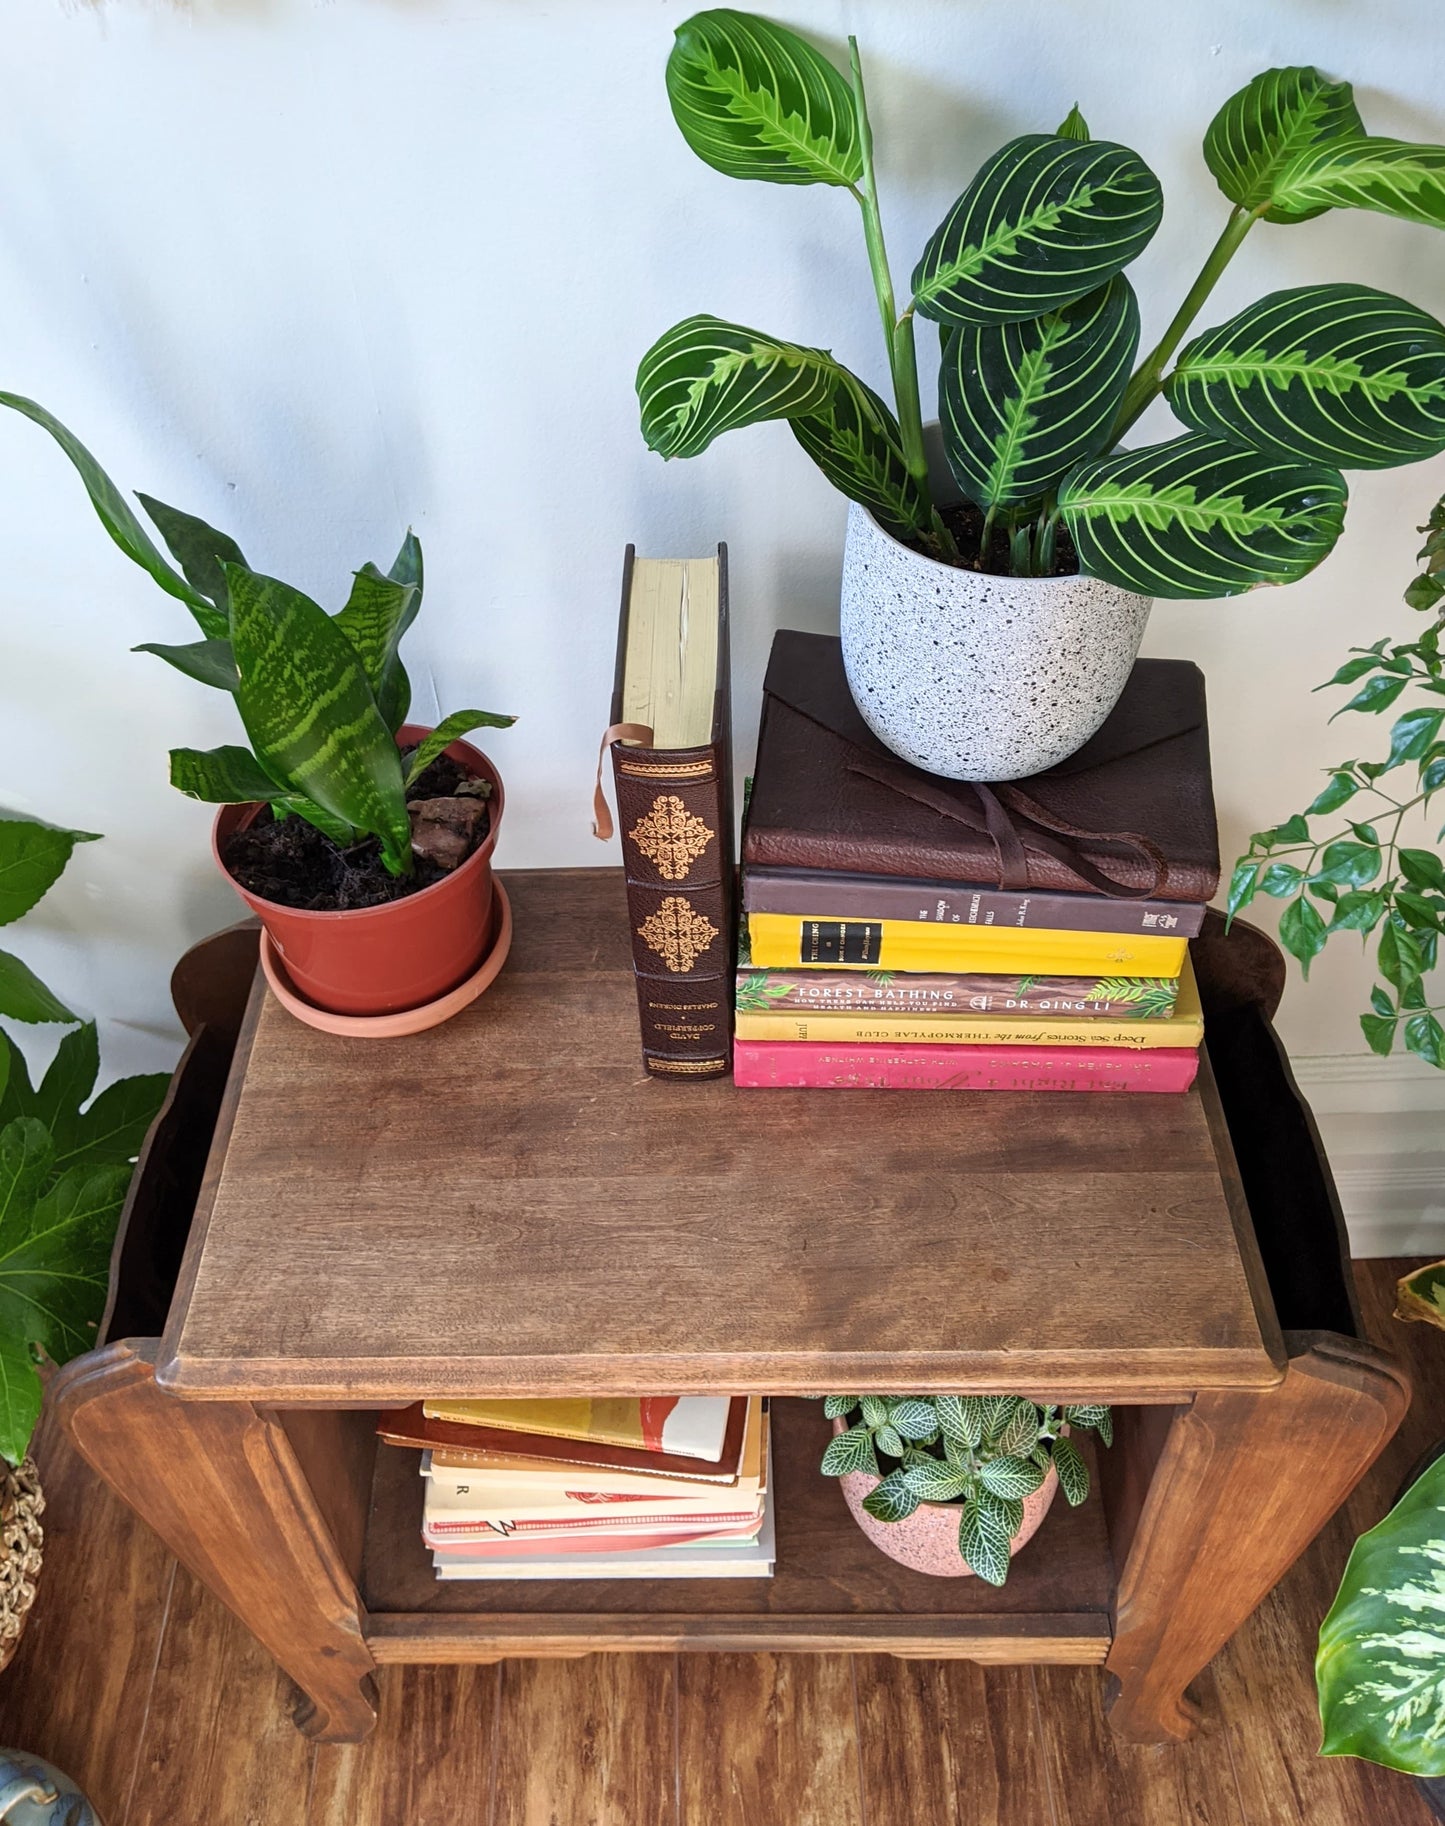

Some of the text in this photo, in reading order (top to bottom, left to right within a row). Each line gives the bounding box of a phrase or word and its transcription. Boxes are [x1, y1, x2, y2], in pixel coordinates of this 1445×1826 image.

[919, 909, 929, 920] THE
[952, 913, 961, 922] OF
[984, 910, 995, 925] FALLS
[799, 987, 955, 1000] FOREST BATHING
[649, 1002, 719, 1010] CHARLES DICKENS
[1005, 1001, 1111, 1011] DR. QING LI
[654, 1023, 716, 1032] COPPERFIELD
[669, 1032, 701, 1040] DAVID
[894, 1031, 992, 1041] THERMOPYLAE
[993, 1032, 1011, 1041] the
[1015, 1032, 1044, 1041] from
[1046, 1033, 1087, 1043] Stories
[1090, 1034, 1111, 1043] Sea
[1113, 1033, 1147, 1044] Deep
[1011, 1077, 1076, 1090] Right
[456, 1485, 470, 1495] R
